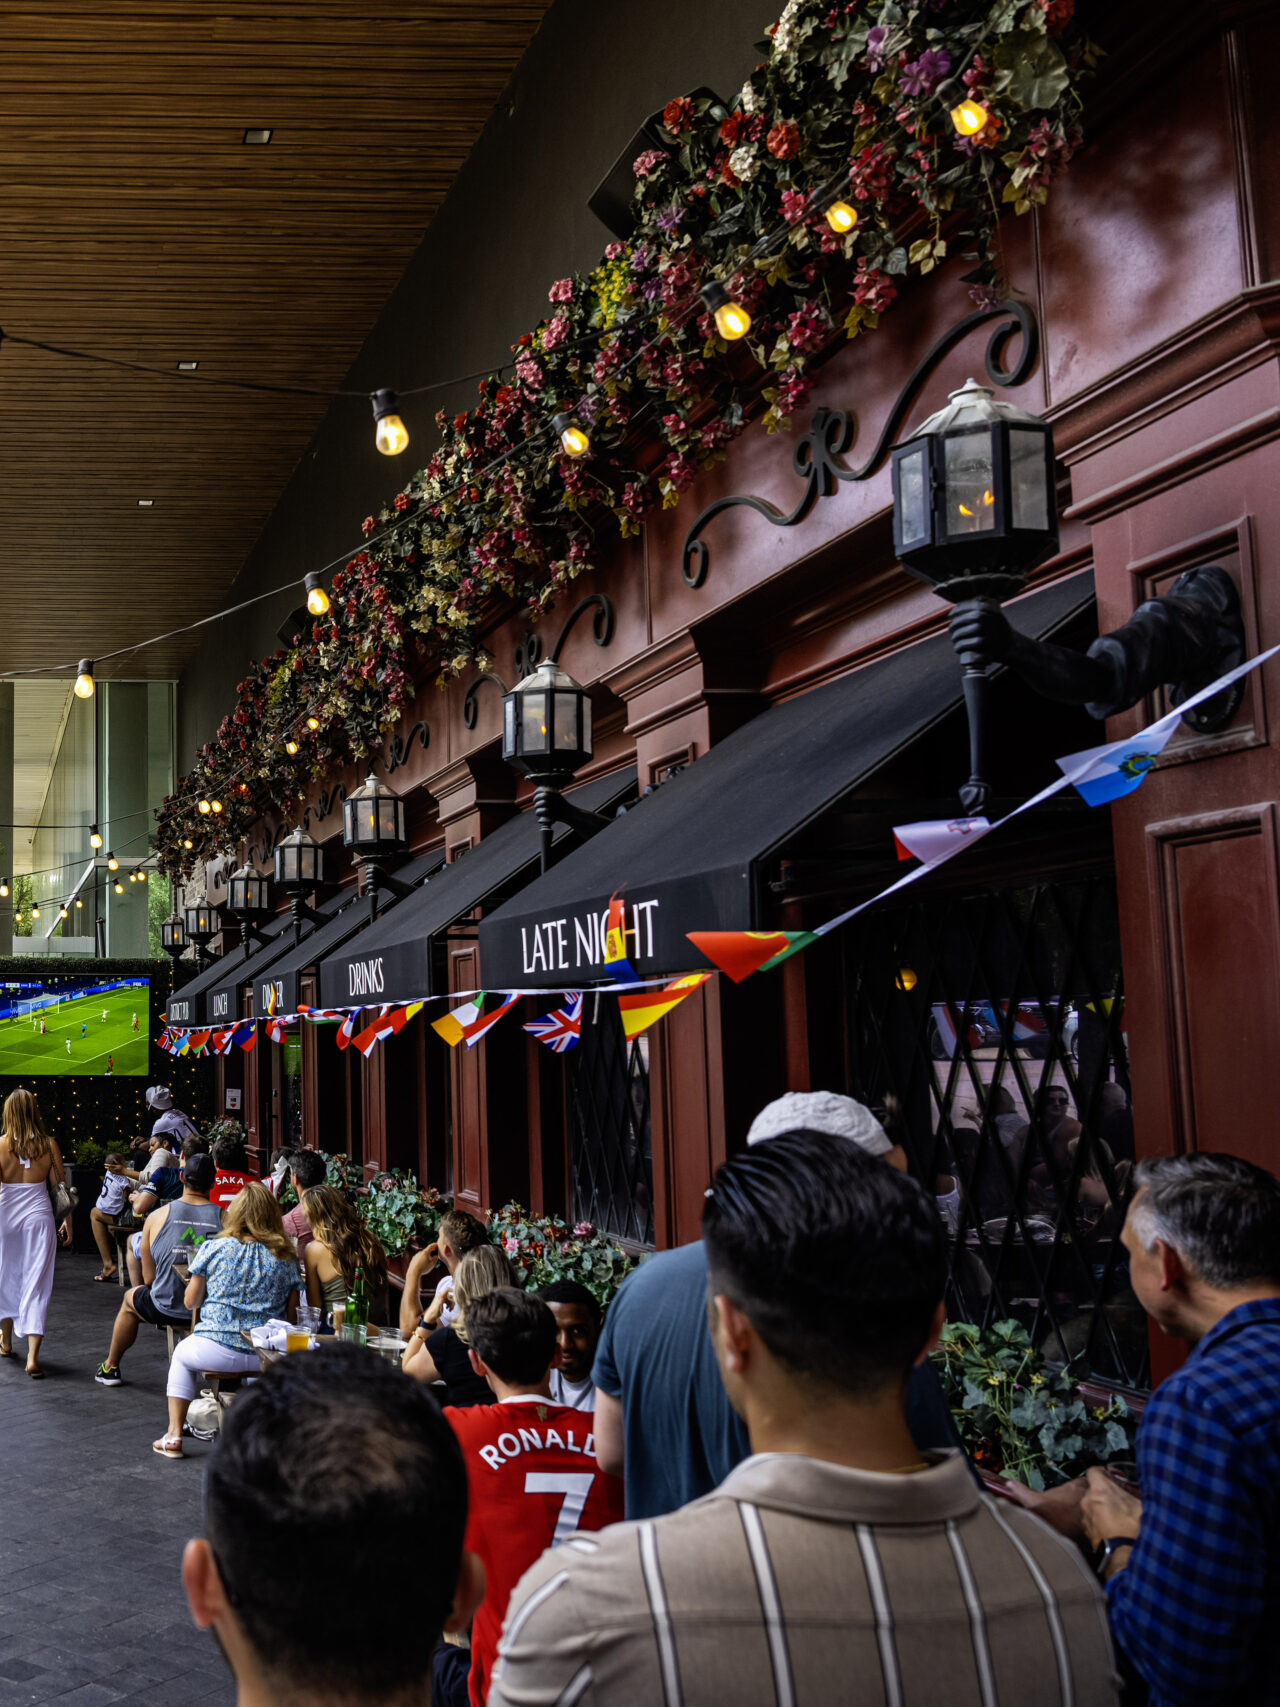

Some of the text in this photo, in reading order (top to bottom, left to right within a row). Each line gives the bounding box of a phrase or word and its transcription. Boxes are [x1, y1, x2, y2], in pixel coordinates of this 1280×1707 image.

[521, 919, 569, 973] LATE
[262, 980, 284, 1010] DINER
[349, 957, 384, 997] DRINKS
[213, 993, 228, 1016] LUNCH
[215, 1176, 244, 1185] SAKA
[479, 1428, 596, 1470] RONALD
[524, 1472, 595, 1550] 7
